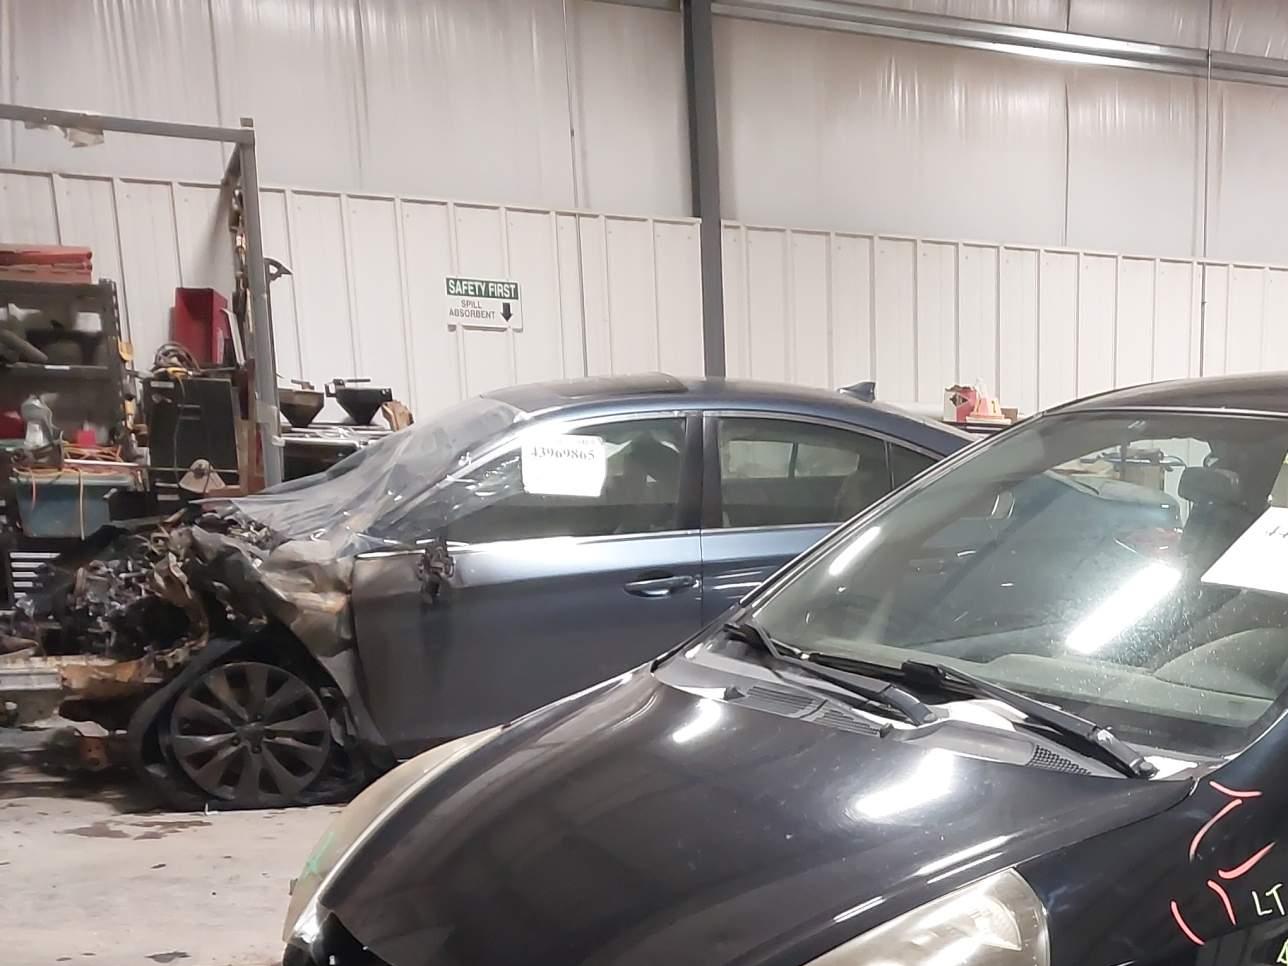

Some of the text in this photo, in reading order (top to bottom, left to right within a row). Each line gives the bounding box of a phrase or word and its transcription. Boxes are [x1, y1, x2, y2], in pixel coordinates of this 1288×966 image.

[448, 279, 516, 299] SAFETY FIRST
[460, 299, 482, 309] SPILL
[449, 308, 495, 320] ABSORBENT
[1251, 883, 1284, 916] LT
